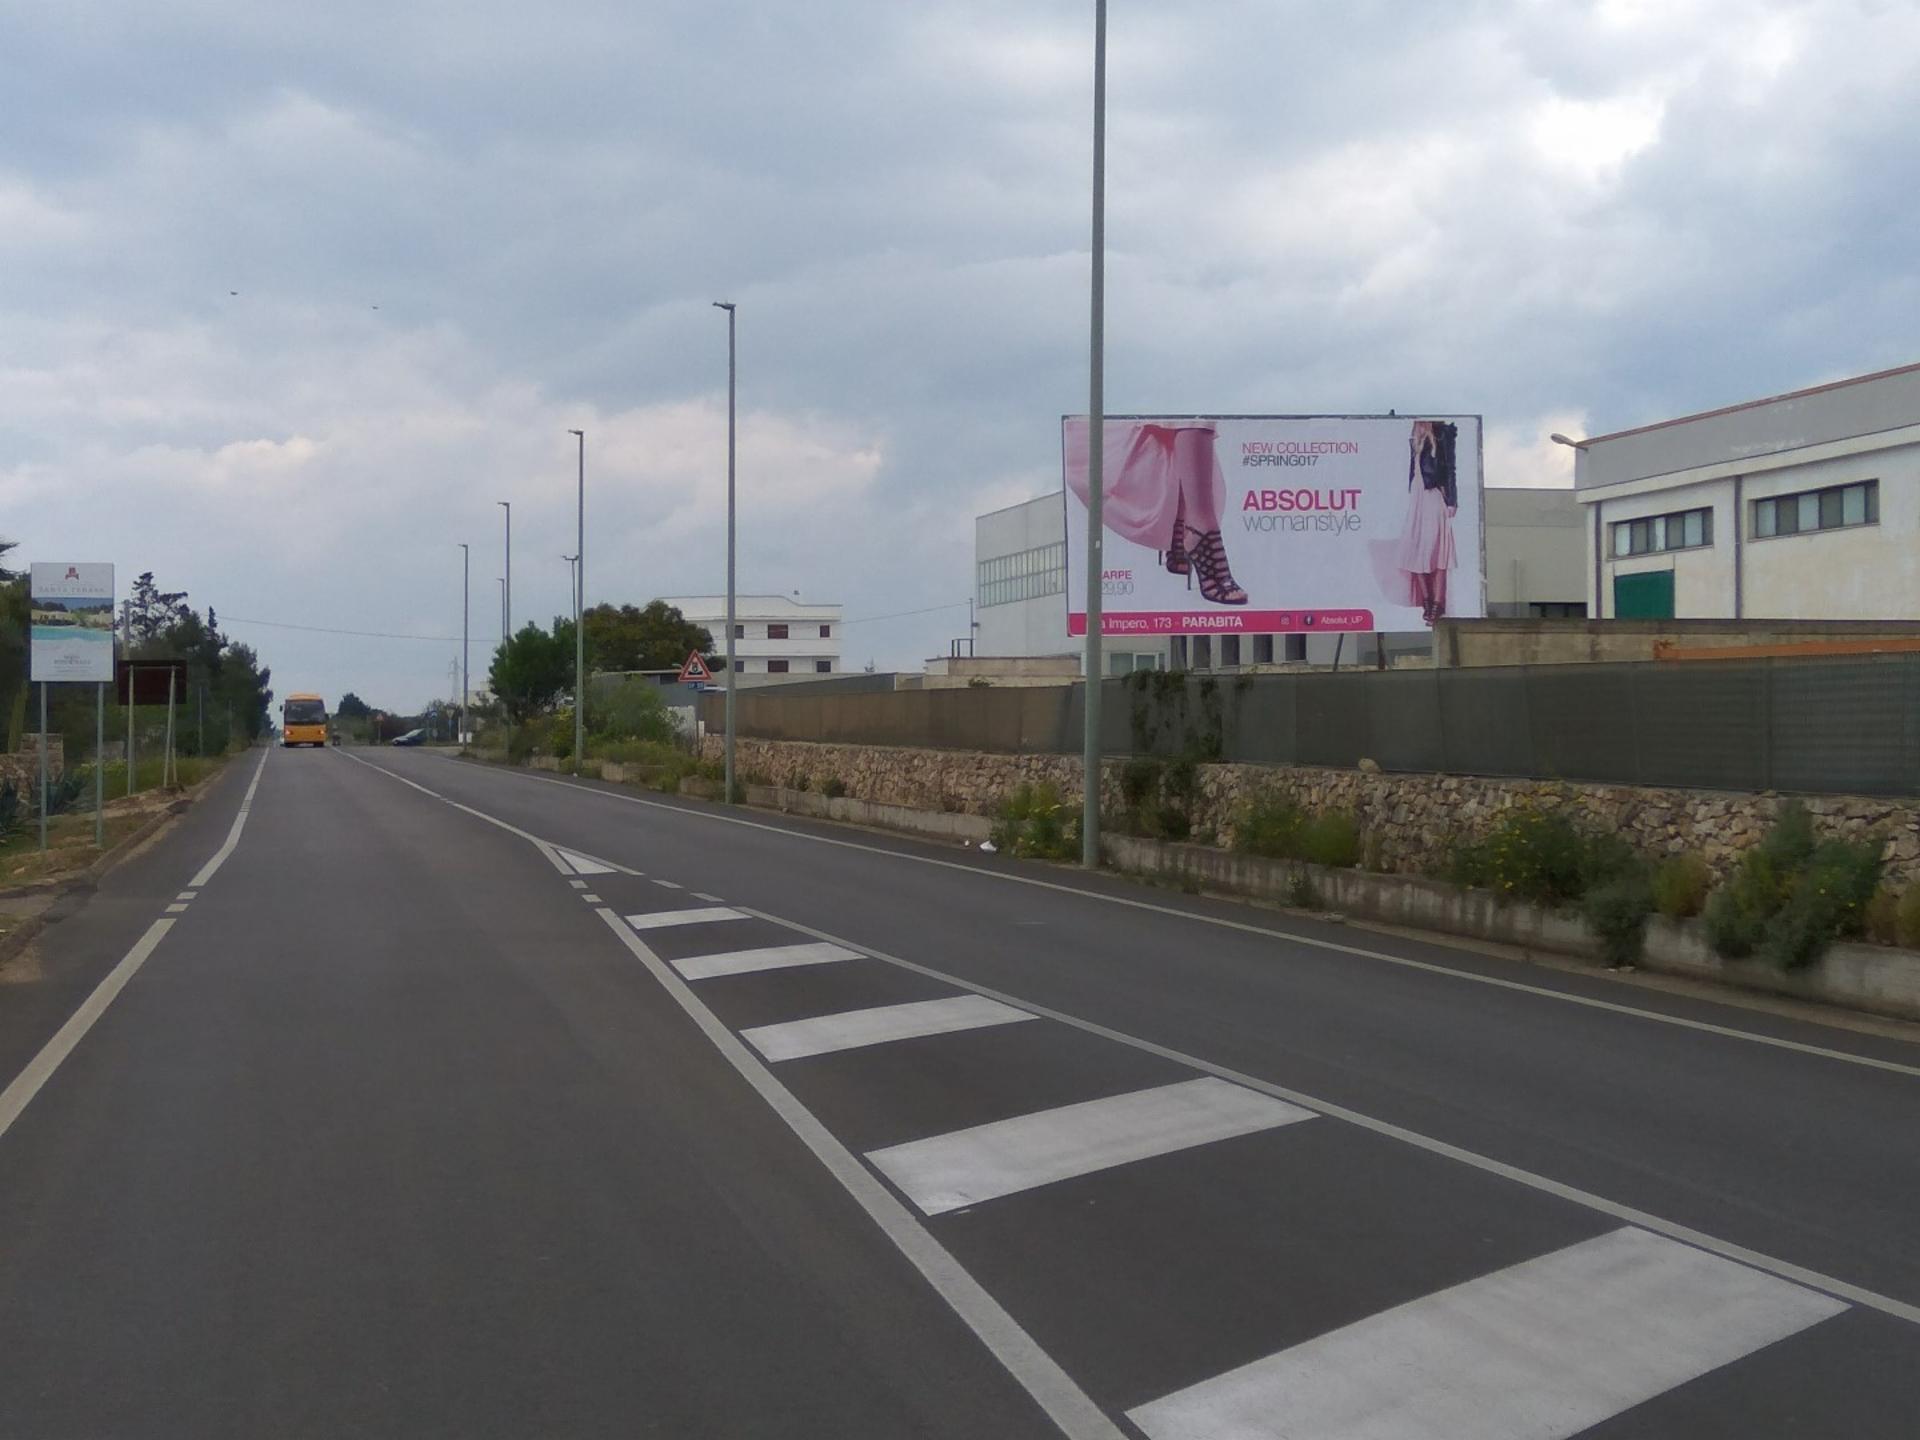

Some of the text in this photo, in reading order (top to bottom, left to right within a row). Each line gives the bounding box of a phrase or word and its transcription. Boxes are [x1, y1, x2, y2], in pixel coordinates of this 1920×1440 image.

[1242, 442, 1359, 454] NEW COLLECTION
[1242, 455, 1319, 467] #SPRING017
[1243, 489, 1362, 511] ABSOLUT
[1243, 511, 1362, 536] womanstyle
[1102, 570, 1132, 579] ARPE
[1102, 581, 1134, 596] 29,90
[1154, 617, 1172, 629] 173
[1182, 615, 1244, 628] PARABITA
